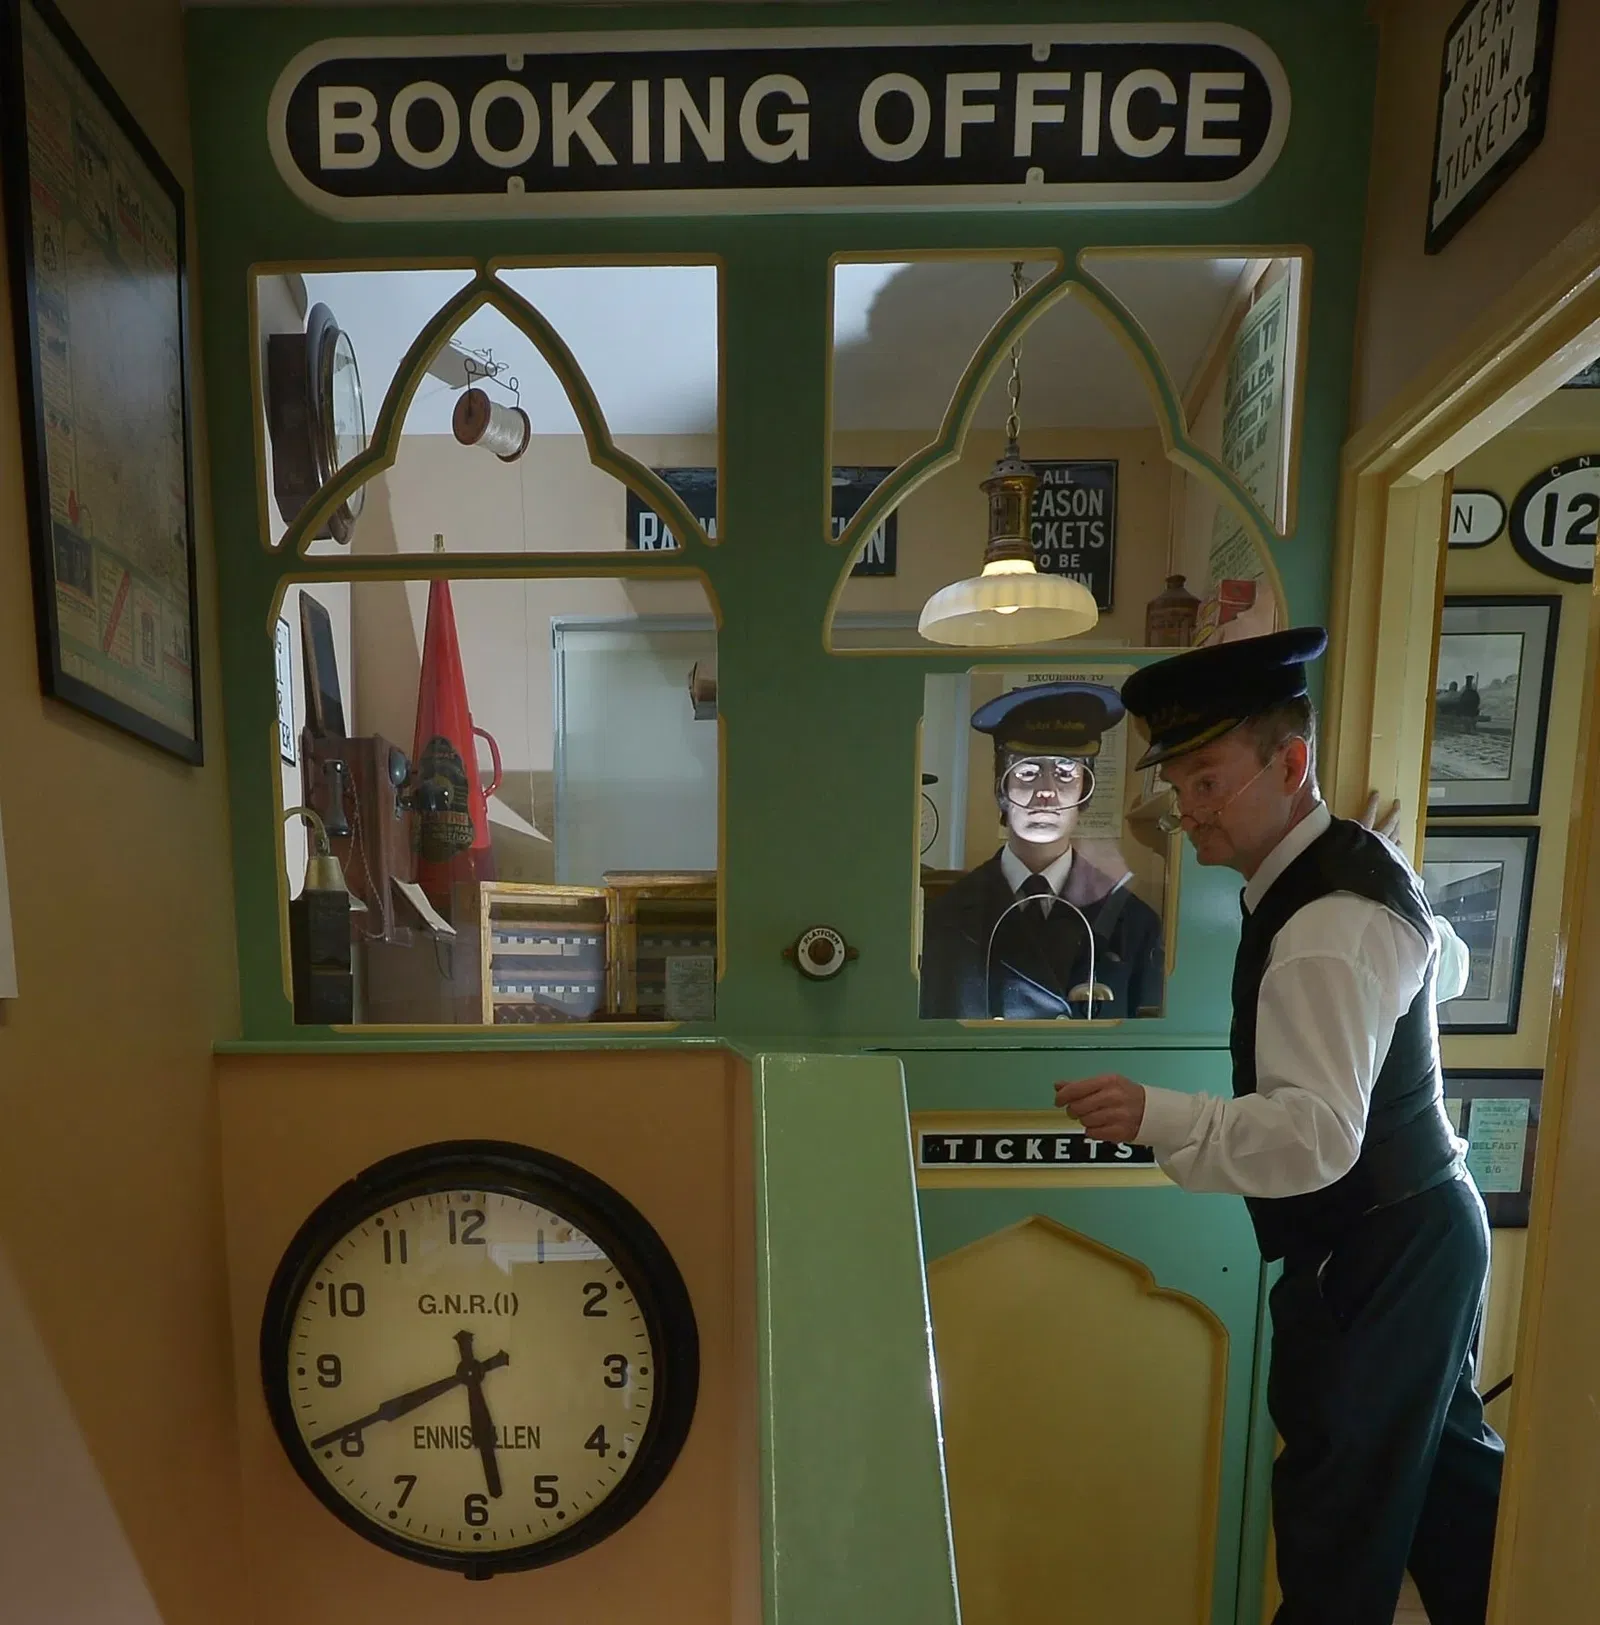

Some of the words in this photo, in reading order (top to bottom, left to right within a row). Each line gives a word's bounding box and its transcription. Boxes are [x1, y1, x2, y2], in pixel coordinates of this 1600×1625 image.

[1460, 26, 1514, 128] SHOW
[317, 73, 810, 170] BOOKING
[858, 69, 1245, 162] OFFICE
[1445, 76, 1522, 199] TICKETS
[1043, 470, 1074, 484] ALL
[1034, 554, 1050, 568] O
[1058, 554, 1080, 568] BE
[1027, 673, 1086, 682] EXCURSION
[944, 1138, 1133, 1160] TICKETS
[1472, 1141, 1518, 1151] BELFAST
[449, 1209, 486, 1245] 12
[384, 1229, 408, 1264] 11
[536, 1228, 545, 1264] 1
[328, 1282, 366, 1318] 10
[582, 1282, 608, 1317] 2
[316, 1354, 342, 1388] 9
[603, 1353, 628, 1388] 3
[413, 1425, 541, 1450] ENNISLLEN
[584, 1424, 611, 1458] 4
[393, 1474, 418, 1508] 7
[534, 1474, 559, 1508] 5
[463, 1493, 489, 1527] 6
